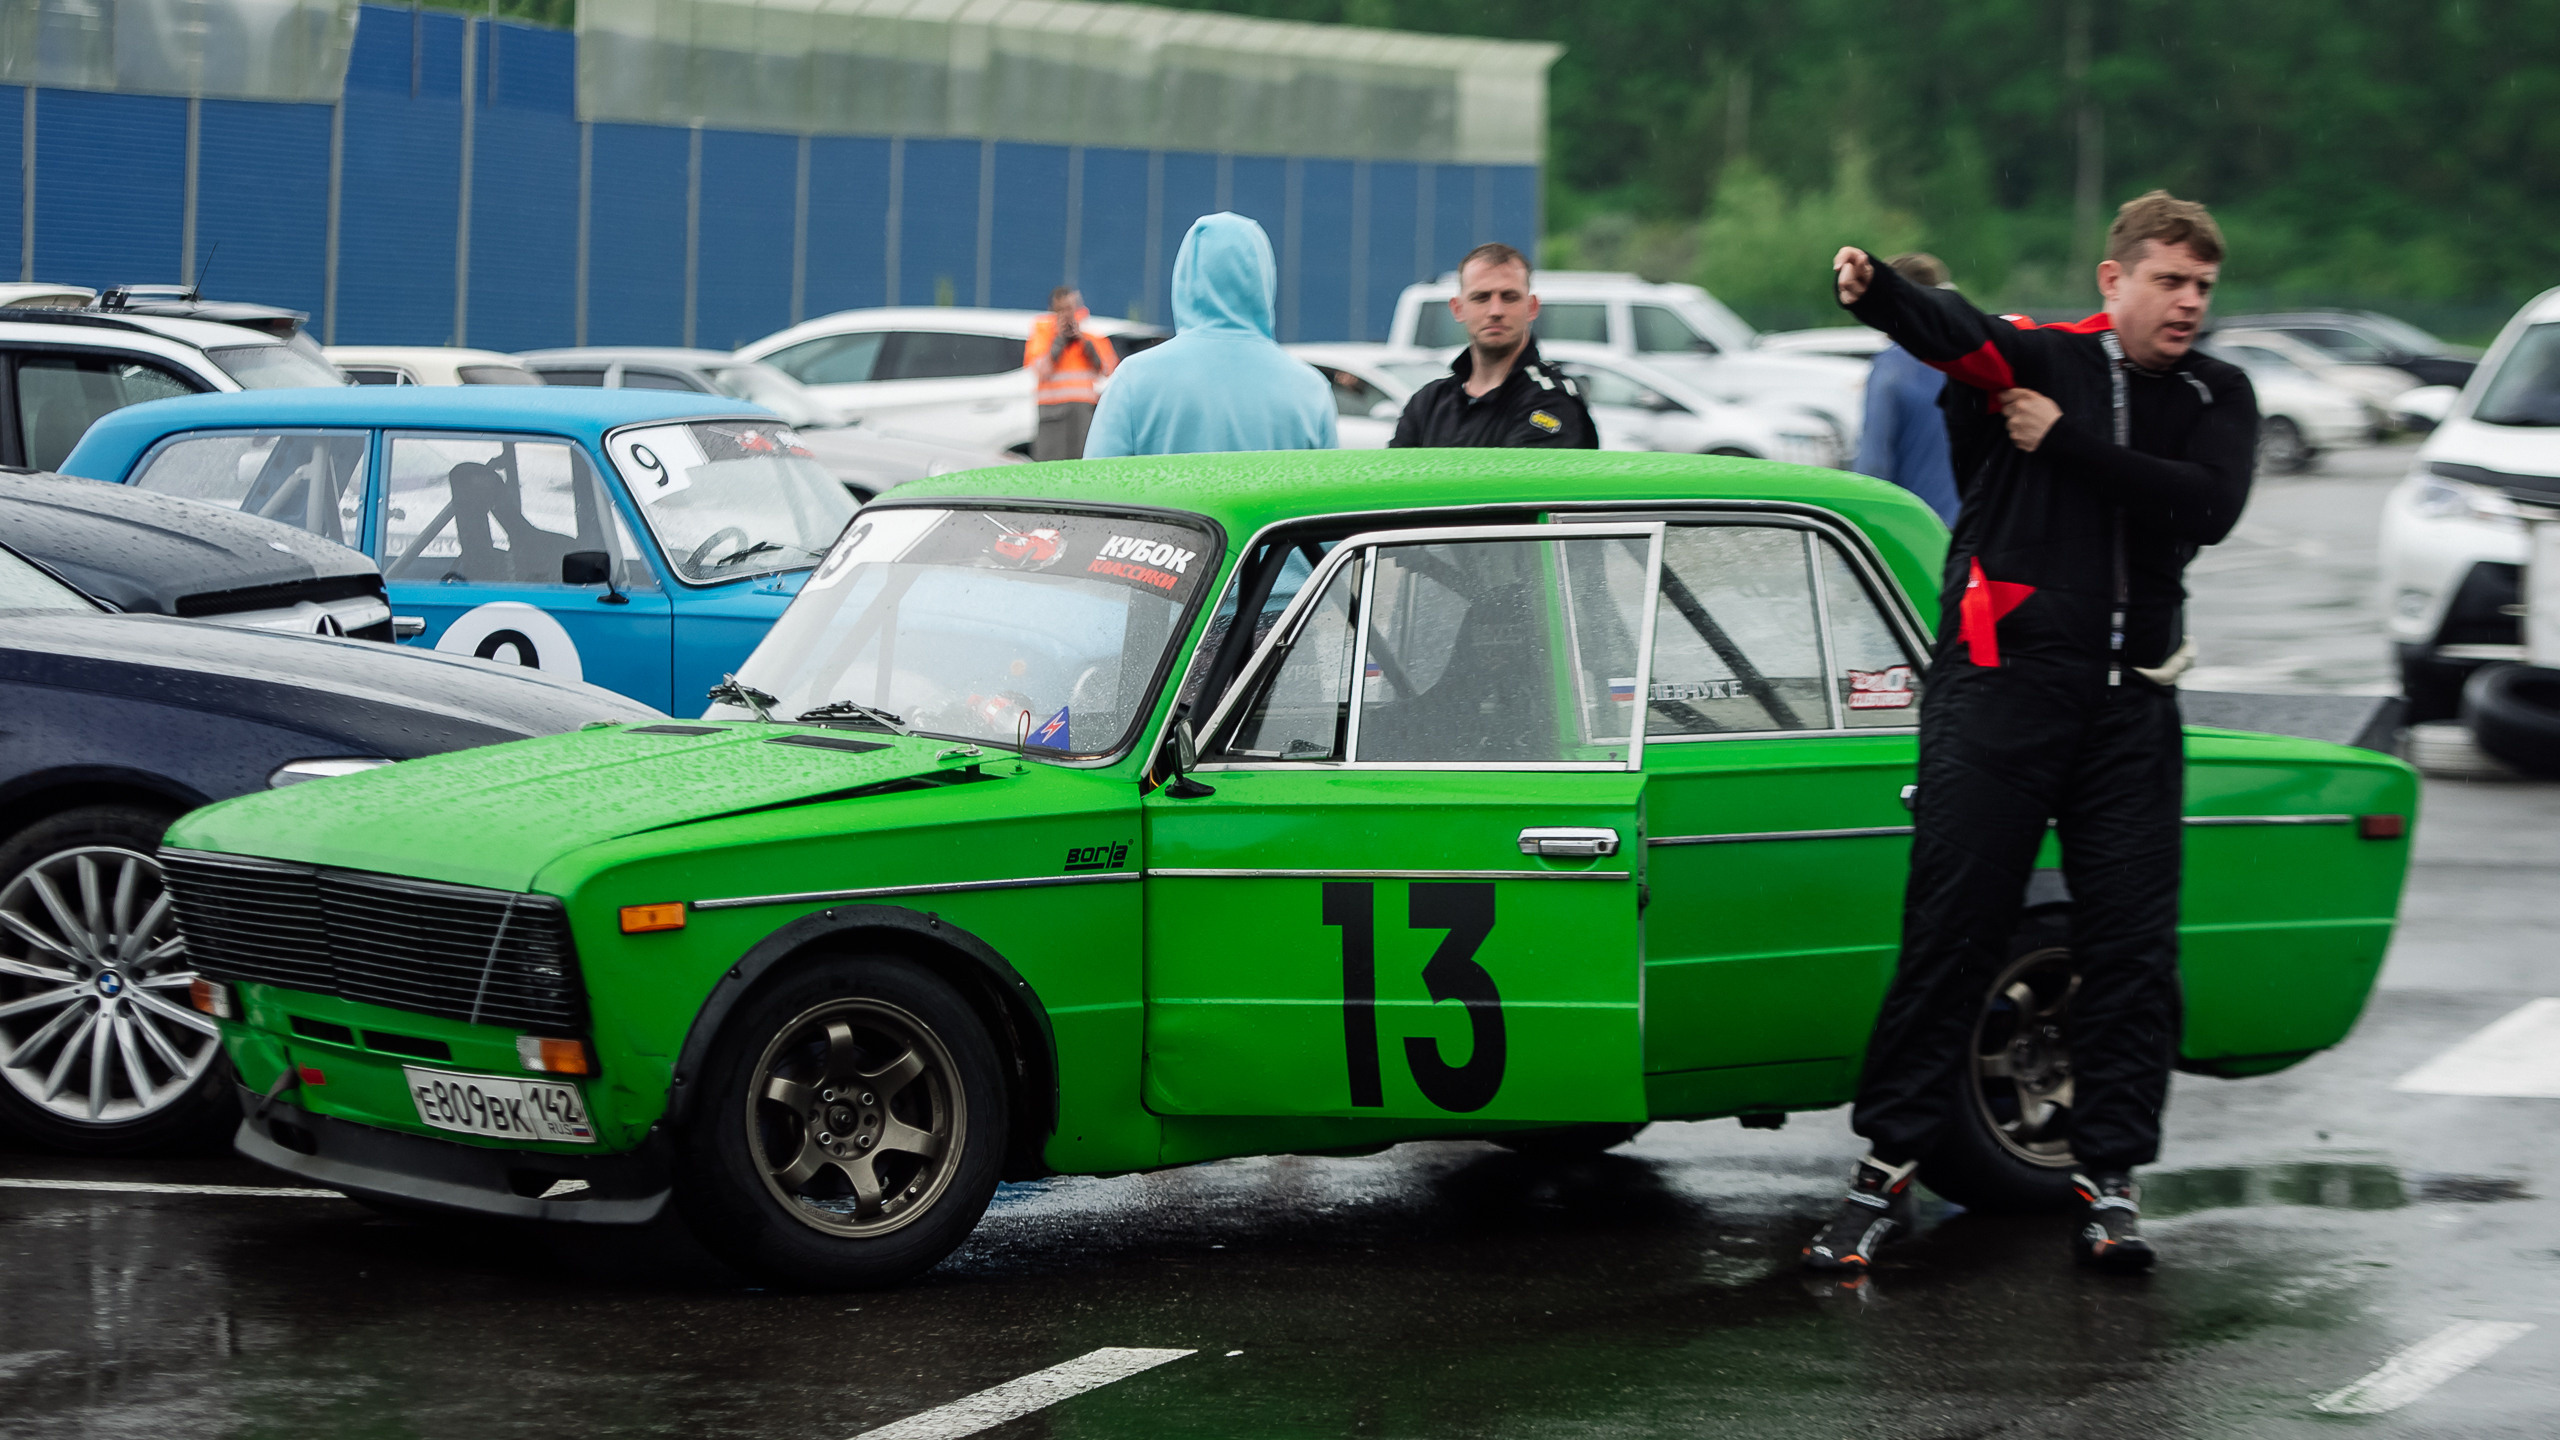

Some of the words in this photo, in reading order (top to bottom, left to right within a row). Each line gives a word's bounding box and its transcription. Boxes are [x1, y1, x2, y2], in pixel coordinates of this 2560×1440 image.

[630, 443, 670, 488] 9
[1099, 535, 1197, 574] КУБОК
[1087, 559, 1178, 591] КЛАССИКИ
[1321, 881, 1507, 1113] 13
[529, 1087, 579, 1123] 142
[547, 1122, 573, 1136] RUS
